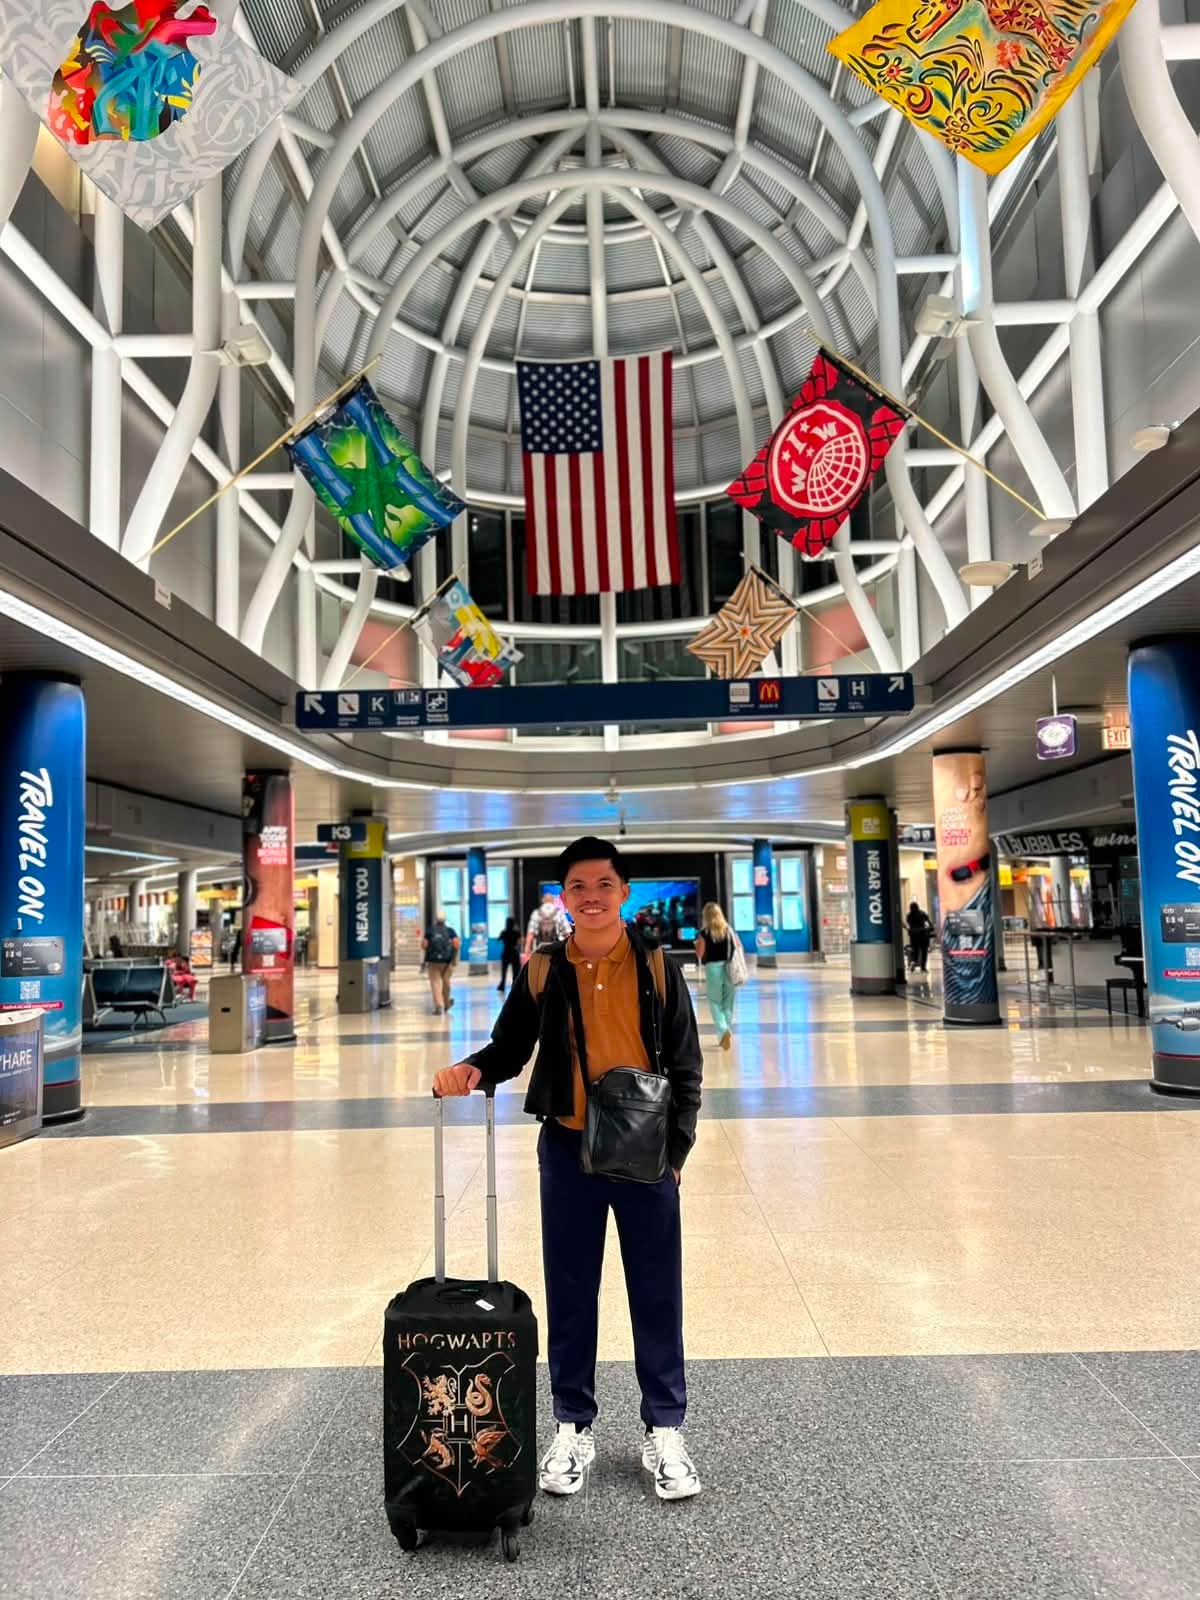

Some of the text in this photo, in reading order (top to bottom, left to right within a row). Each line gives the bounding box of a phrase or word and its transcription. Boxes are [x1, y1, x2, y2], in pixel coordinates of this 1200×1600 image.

[851, 680, 865, 697] H
[371, 696, 385, 712] K
[1107, 729, 1128, 744] EXIT
[1166, 729, 1200, 836] TRAVEL
[17, 767, 53, 871] TRAVEL
[331, 826, 352, 840] K3
[1174, 840, 1200, 885] ON
[867, 850, 883, 924] NEAR YOU
[355, 867, 369, 942] NEAR YOU
[398, 1331, 517, 1349] HOGWARTS
[451, 1414, 468, 1433] H
